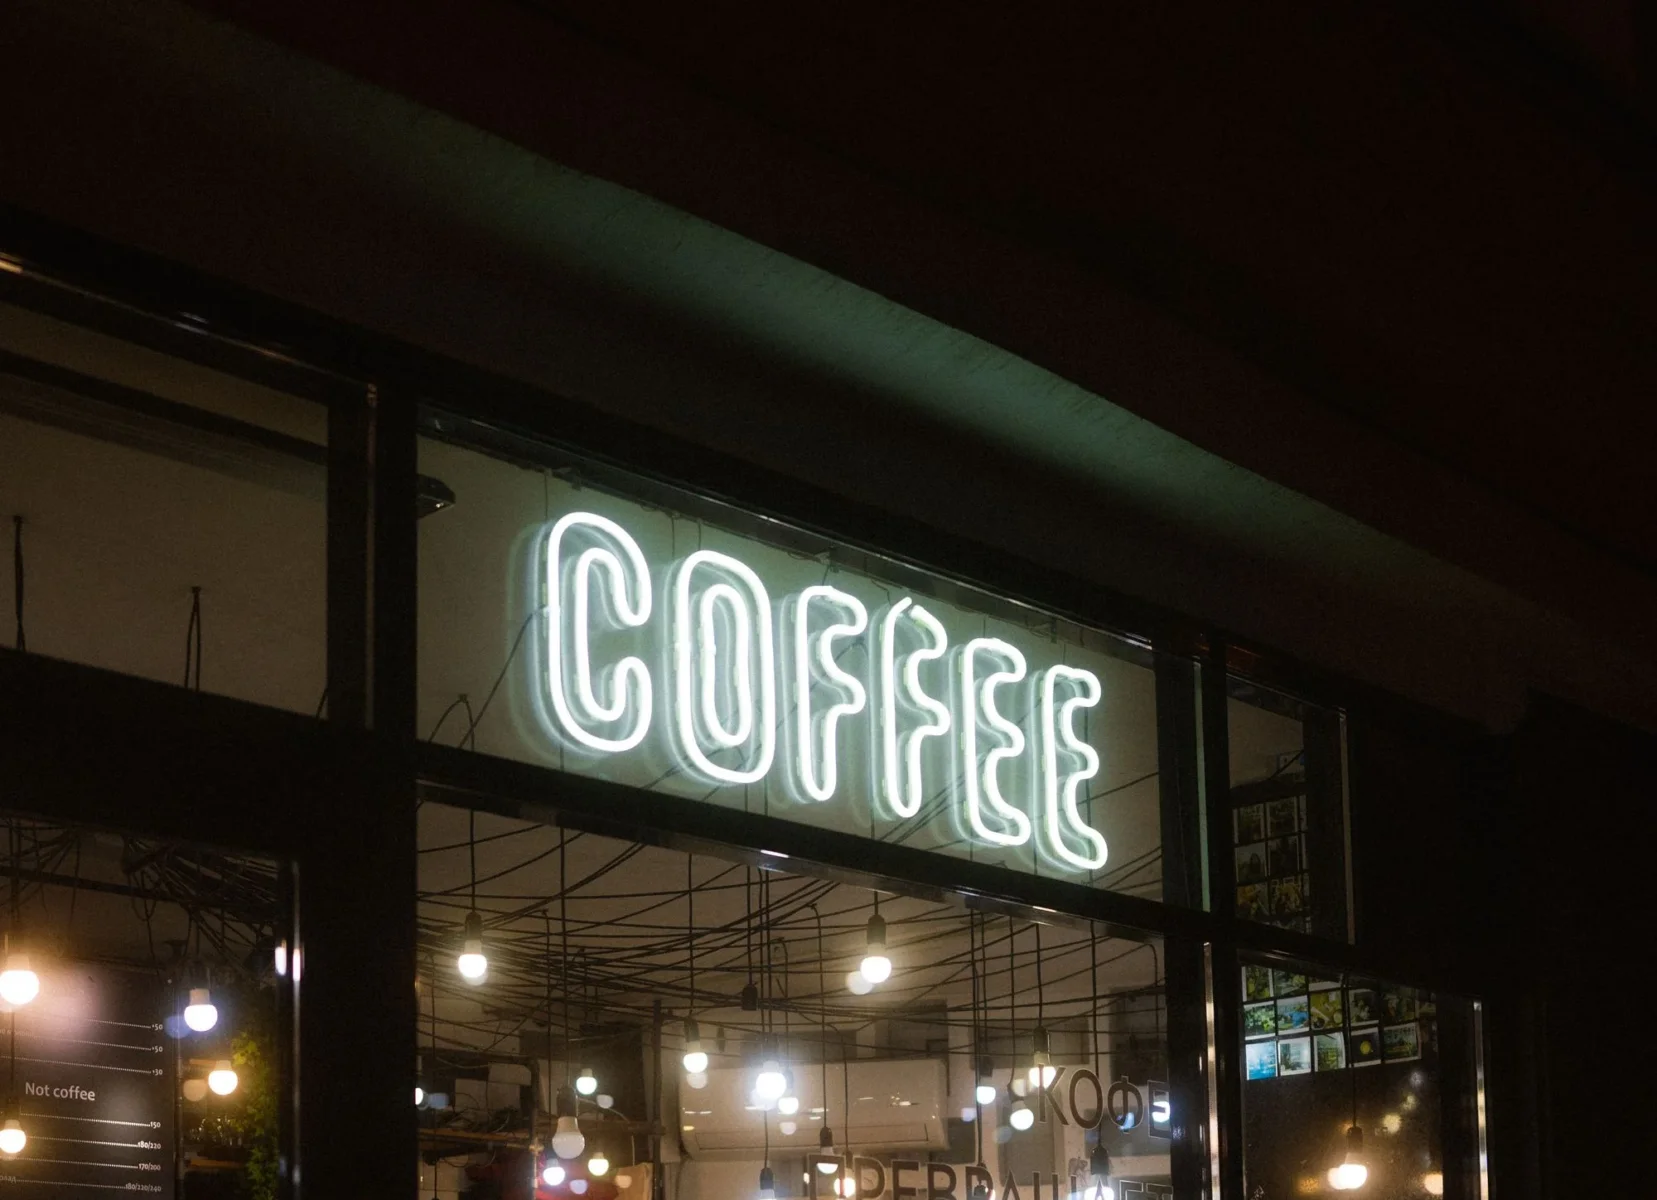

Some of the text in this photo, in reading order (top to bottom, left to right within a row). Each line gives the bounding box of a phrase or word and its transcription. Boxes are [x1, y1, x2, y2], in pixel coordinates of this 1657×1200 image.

[546, 511, 1108, 870] COFFEE
[25, 1081, 96, 1101] Not coffee
[1037, 1063, 1172, 1140] КОФЕ
